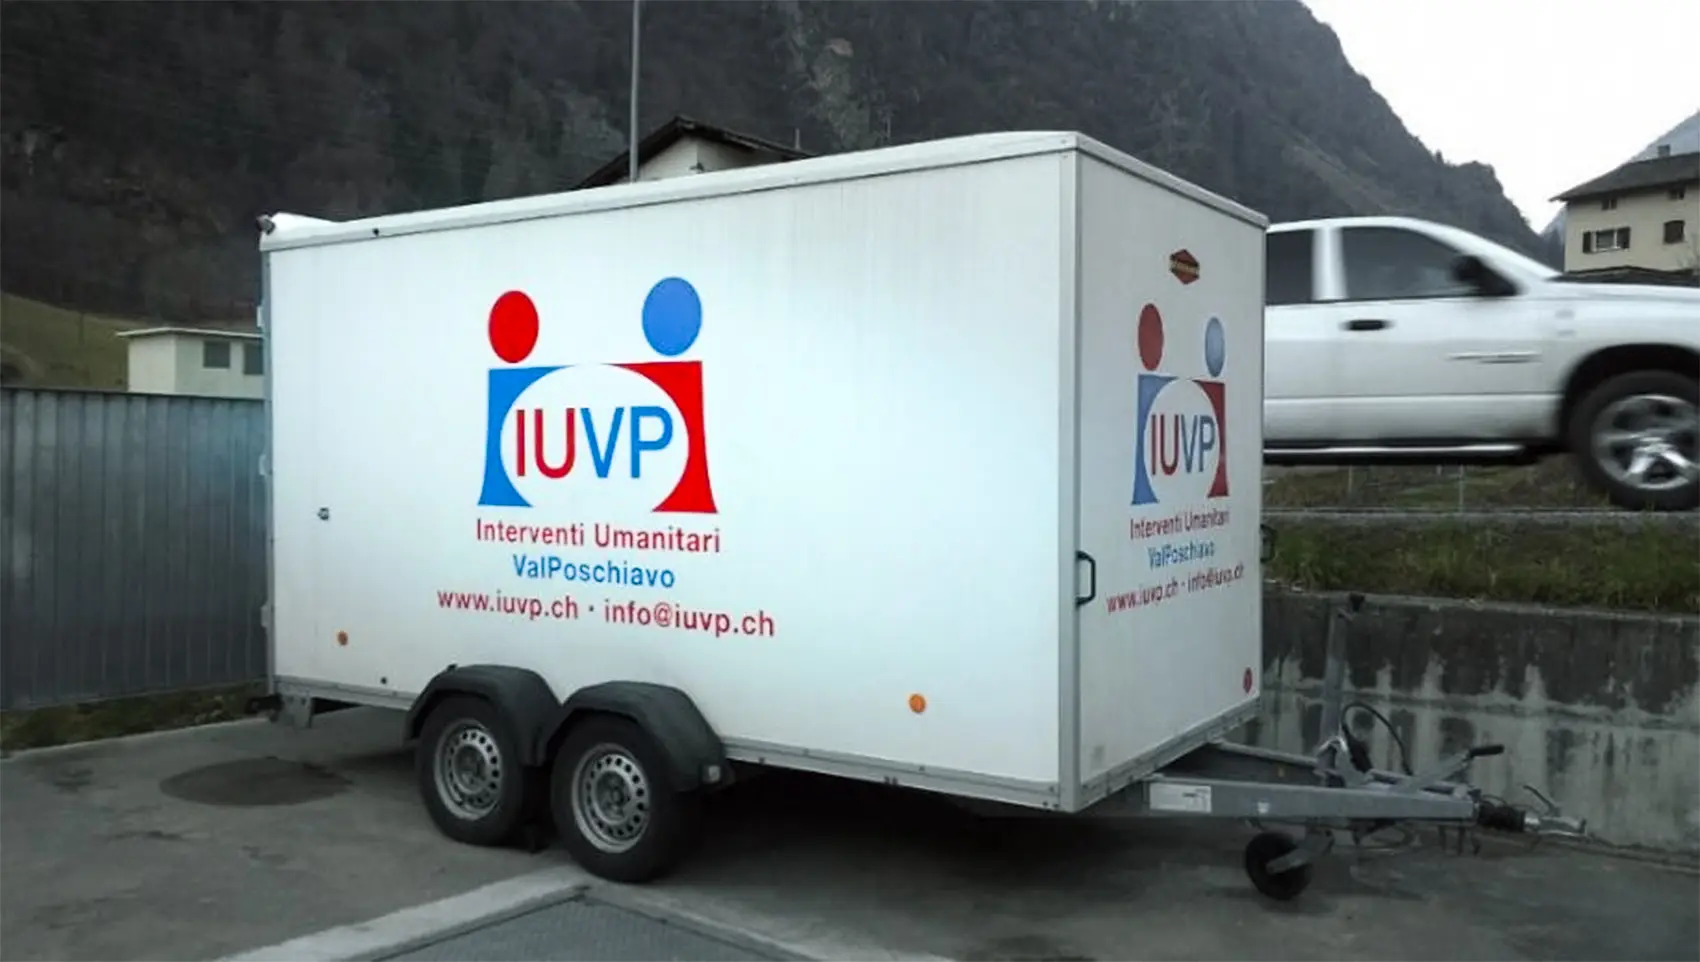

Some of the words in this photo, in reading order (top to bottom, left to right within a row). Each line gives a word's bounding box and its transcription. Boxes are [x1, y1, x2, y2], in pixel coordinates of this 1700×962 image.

[515, 405, 674, 480] IUVP
[1150, 413, 1215, 476] IUVP
[476, 518, 585, 547] Interventi
[594, 523, 721, 553] Umanitari
[1130, 515, 1181, 540] Interventi
[512, 554, 676, 589] ValPoschiavo
[437, 590, 579, 621] www.iuvp.ch
[604, 599, 776, 638] info@iuvp.ch
